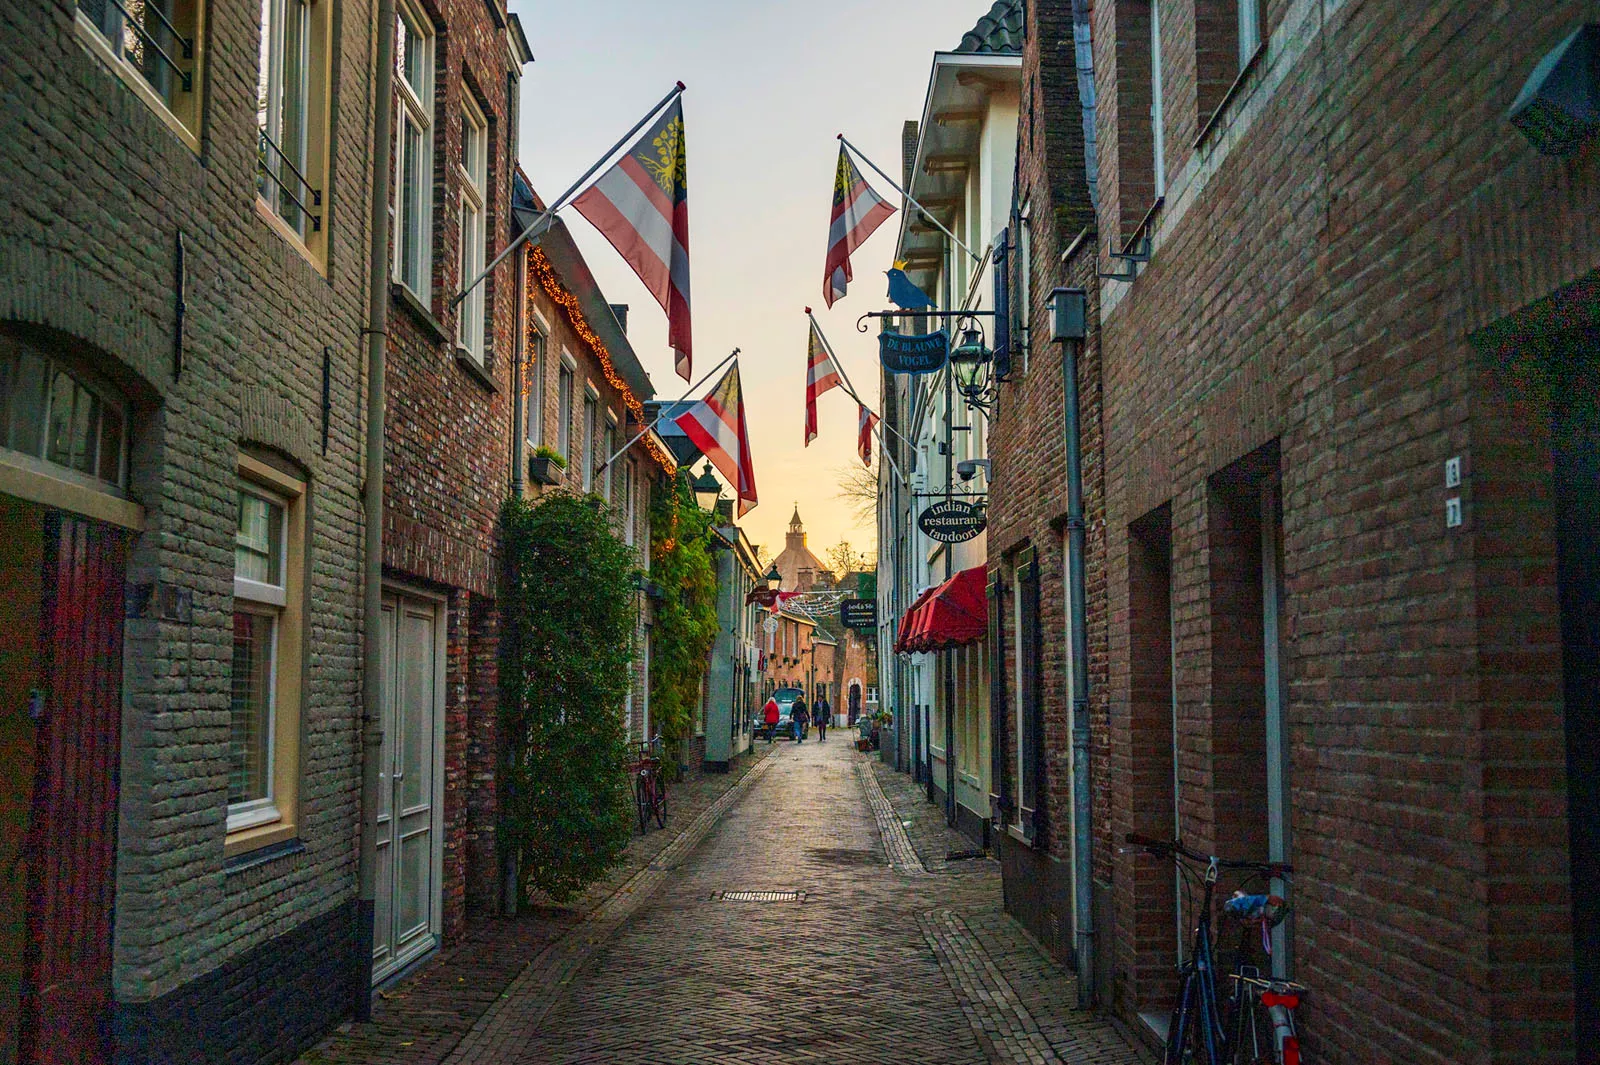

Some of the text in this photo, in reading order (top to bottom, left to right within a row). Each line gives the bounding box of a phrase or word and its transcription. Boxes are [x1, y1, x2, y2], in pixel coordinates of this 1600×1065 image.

[887, 338, 942, 352] DE BLAUWE
[899, 355, 931, 366] VOGEL
[931, 500, 971, 515] indian
[924, 516, 981, 526] restauran
[929, 525, 978, 542] tandoori
